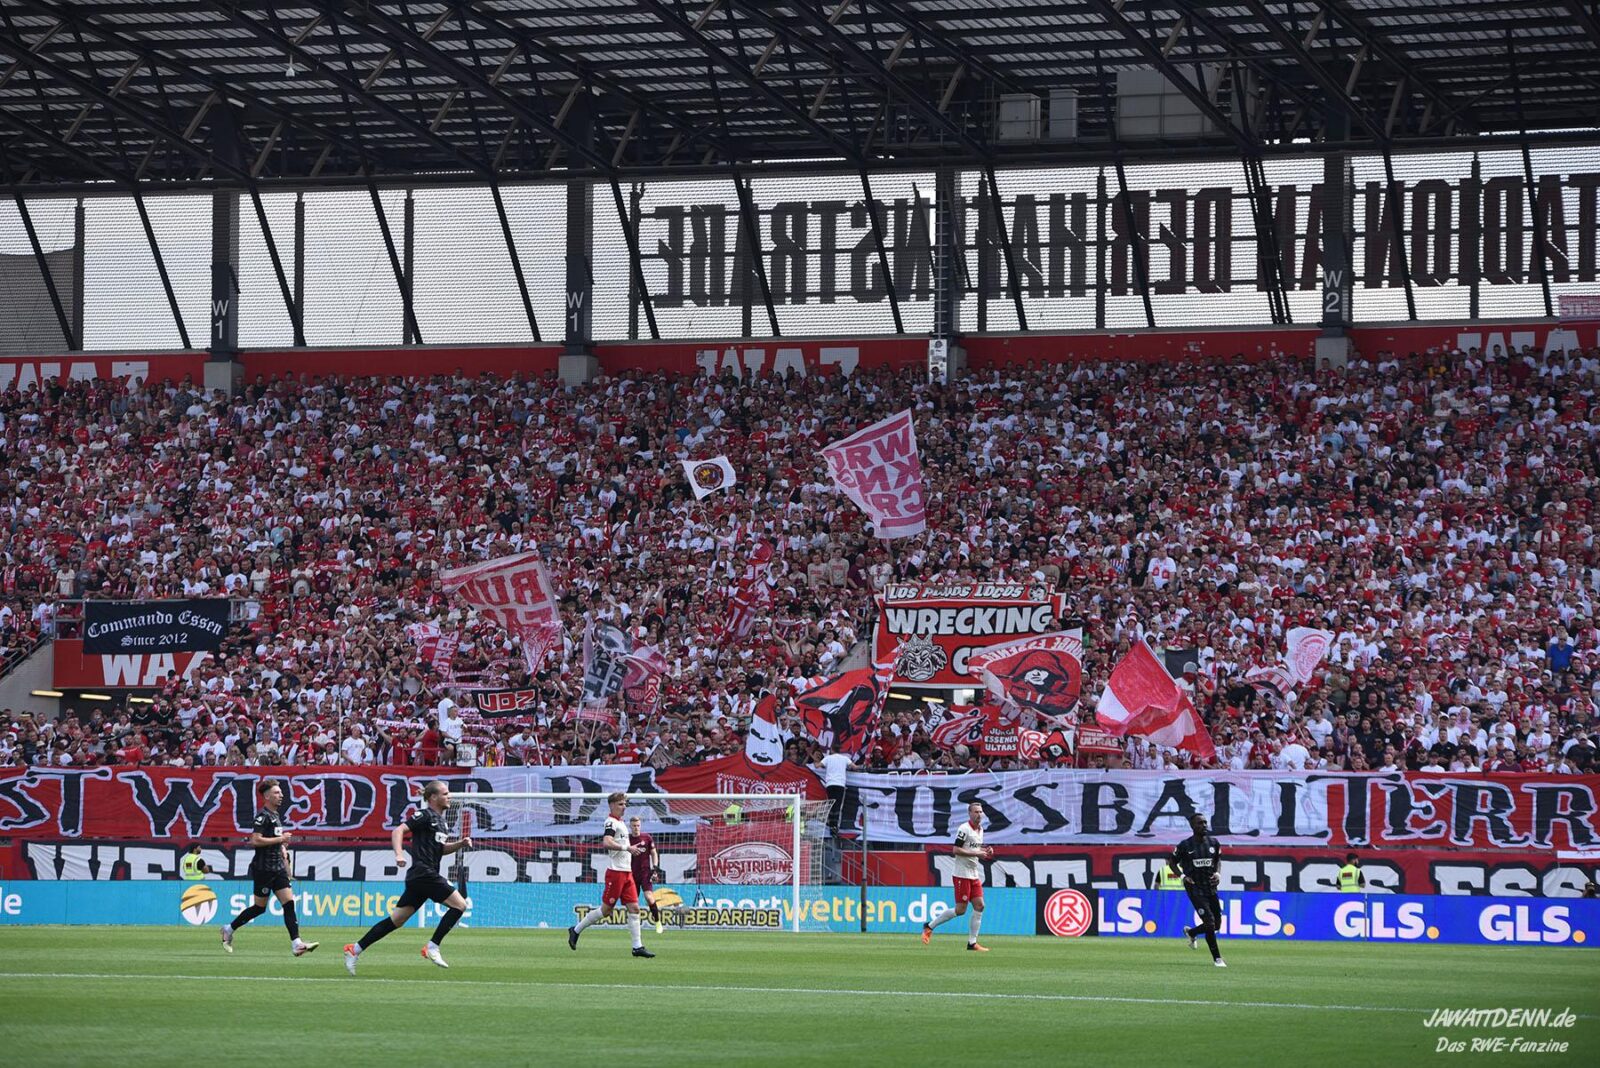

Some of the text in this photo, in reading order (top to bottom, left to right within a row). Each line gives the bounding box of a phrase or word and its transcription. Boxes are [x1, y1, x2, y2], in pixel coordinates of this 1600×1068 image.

[1322, 270, 1343, 313] W 2
[212, 299, 230, 340] W 1
[565, 291, 583, 332] W 1
[87, 609, 224, 638] Commando Essen
[884, 605, 1053, 636] WRECKING
[120, 632, 188, 647] Since 2012
[544, 770, 682, 827] DA
[1434, 866, 1600, 899] ESS
